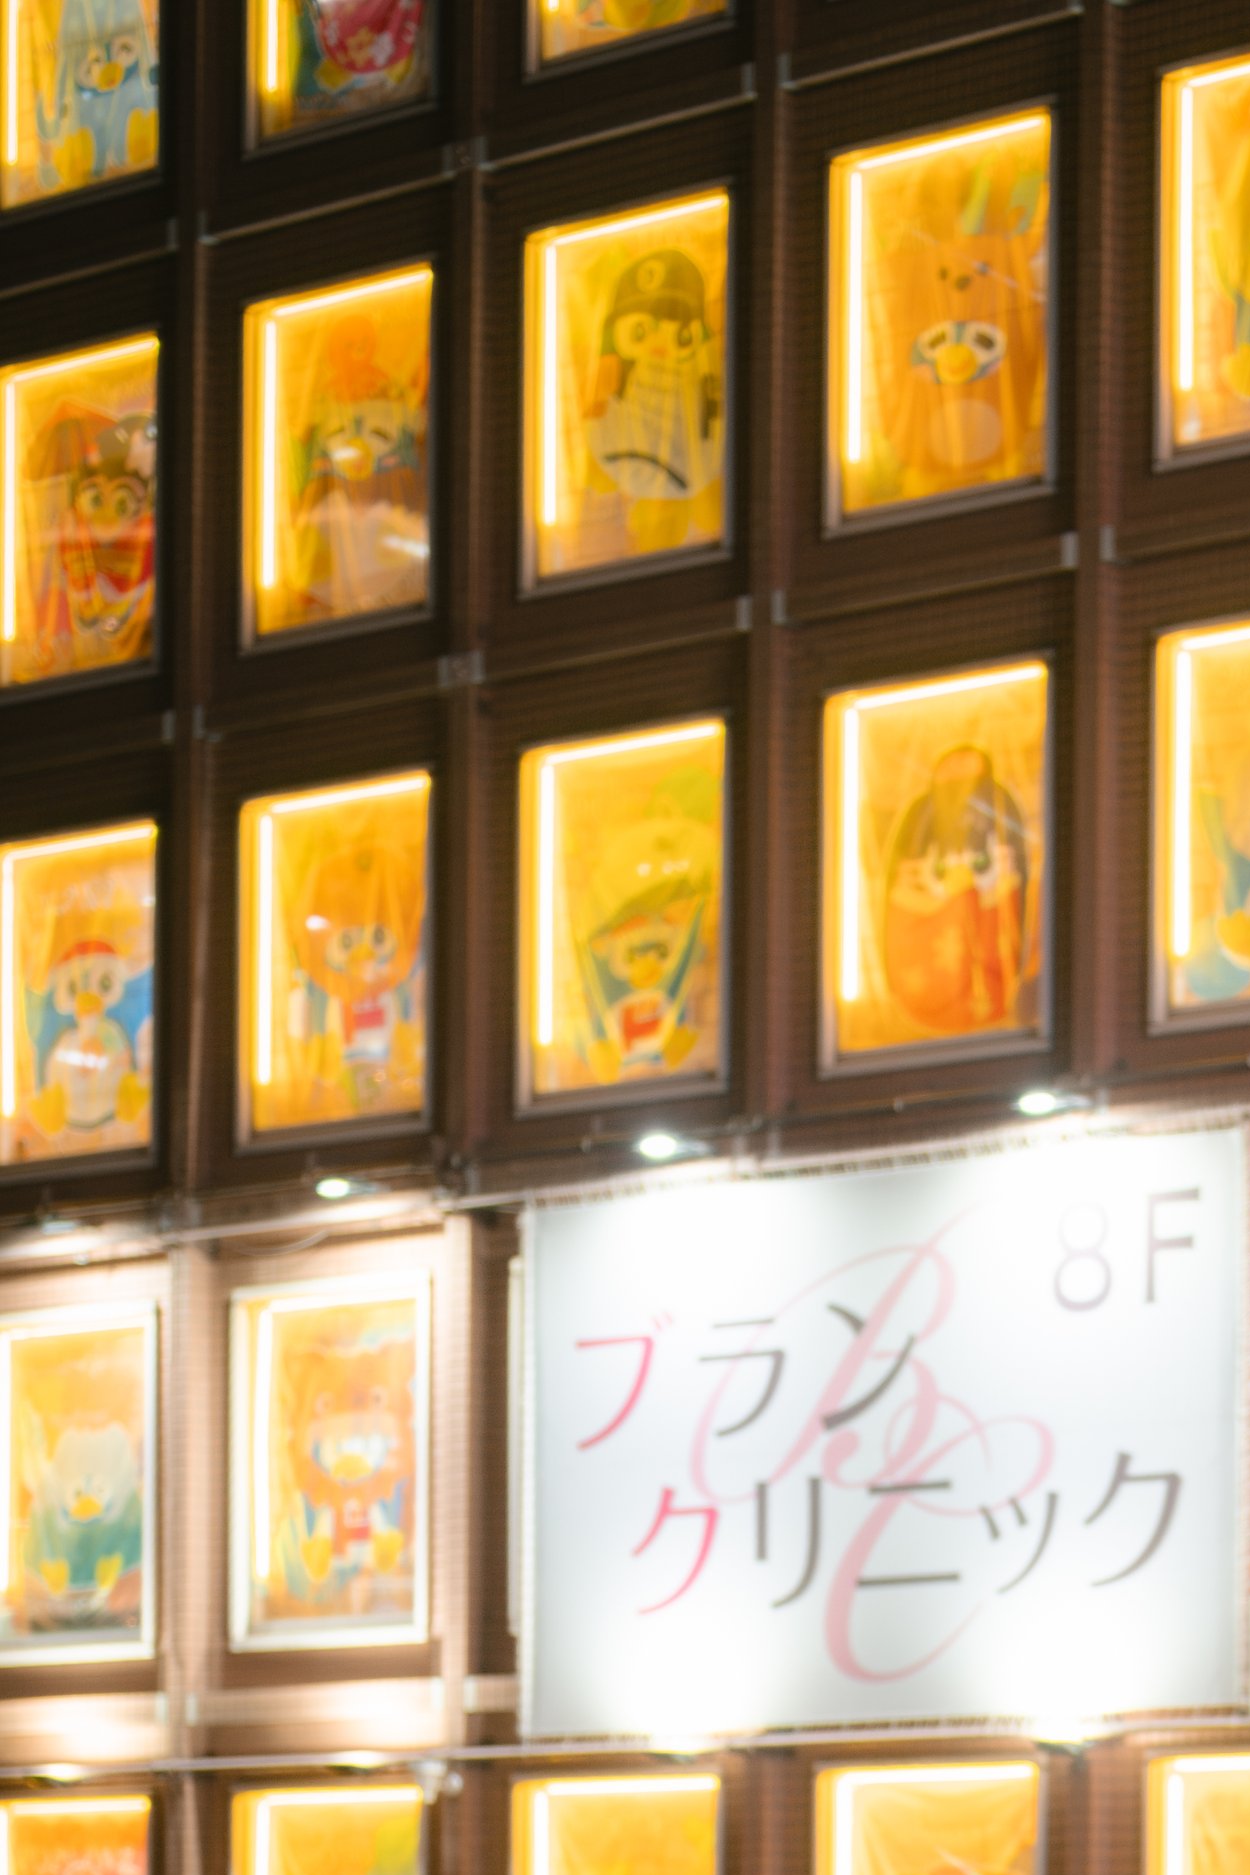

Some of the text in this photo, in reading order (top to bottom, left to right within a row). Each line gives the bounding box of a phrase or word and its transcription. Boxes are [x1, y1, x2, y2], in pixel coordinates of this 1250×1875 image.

[575, 1302, 916, 1450] ブラン
[633, 1452, 1184, 1616] クリニック
